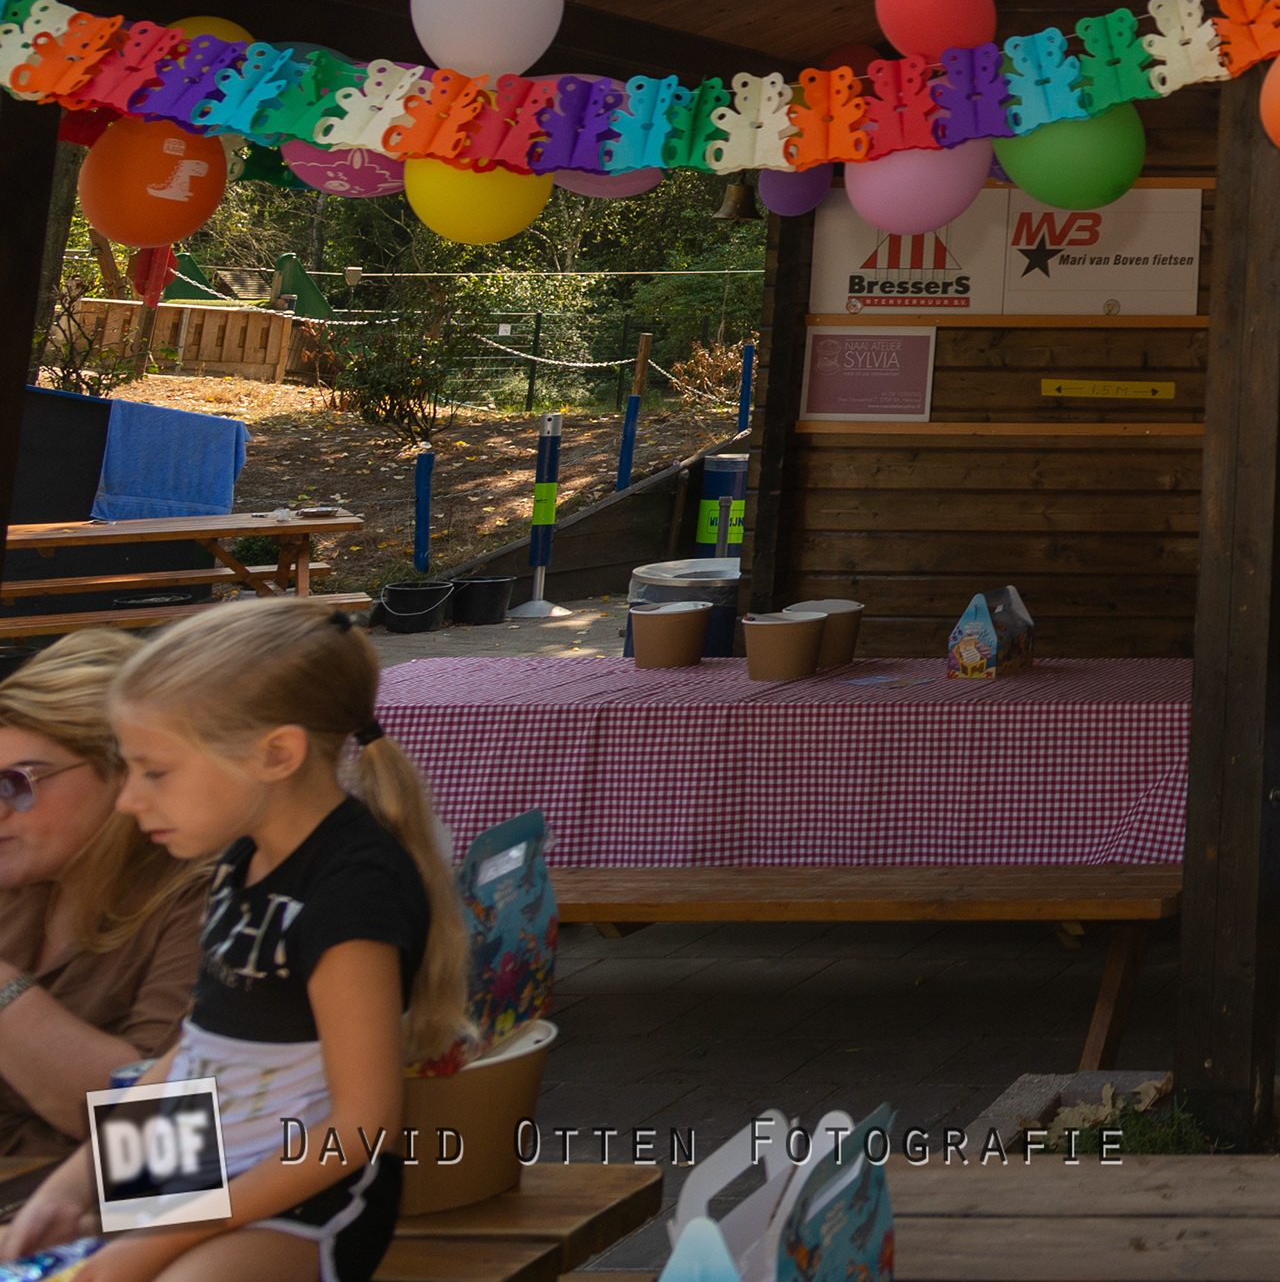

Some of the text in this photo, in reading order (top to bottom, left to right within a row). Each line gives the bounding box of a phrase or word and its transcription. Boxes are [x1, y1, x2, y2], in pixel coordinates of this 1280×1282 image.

[1058, 252, 1194, 267] Mari van Boven fietsen
[861, 298, 949, 306] NTENVERHUUR
[871, 342, 903, 351] ATELIER
[844, 350, 900, 368] SYLVIA
